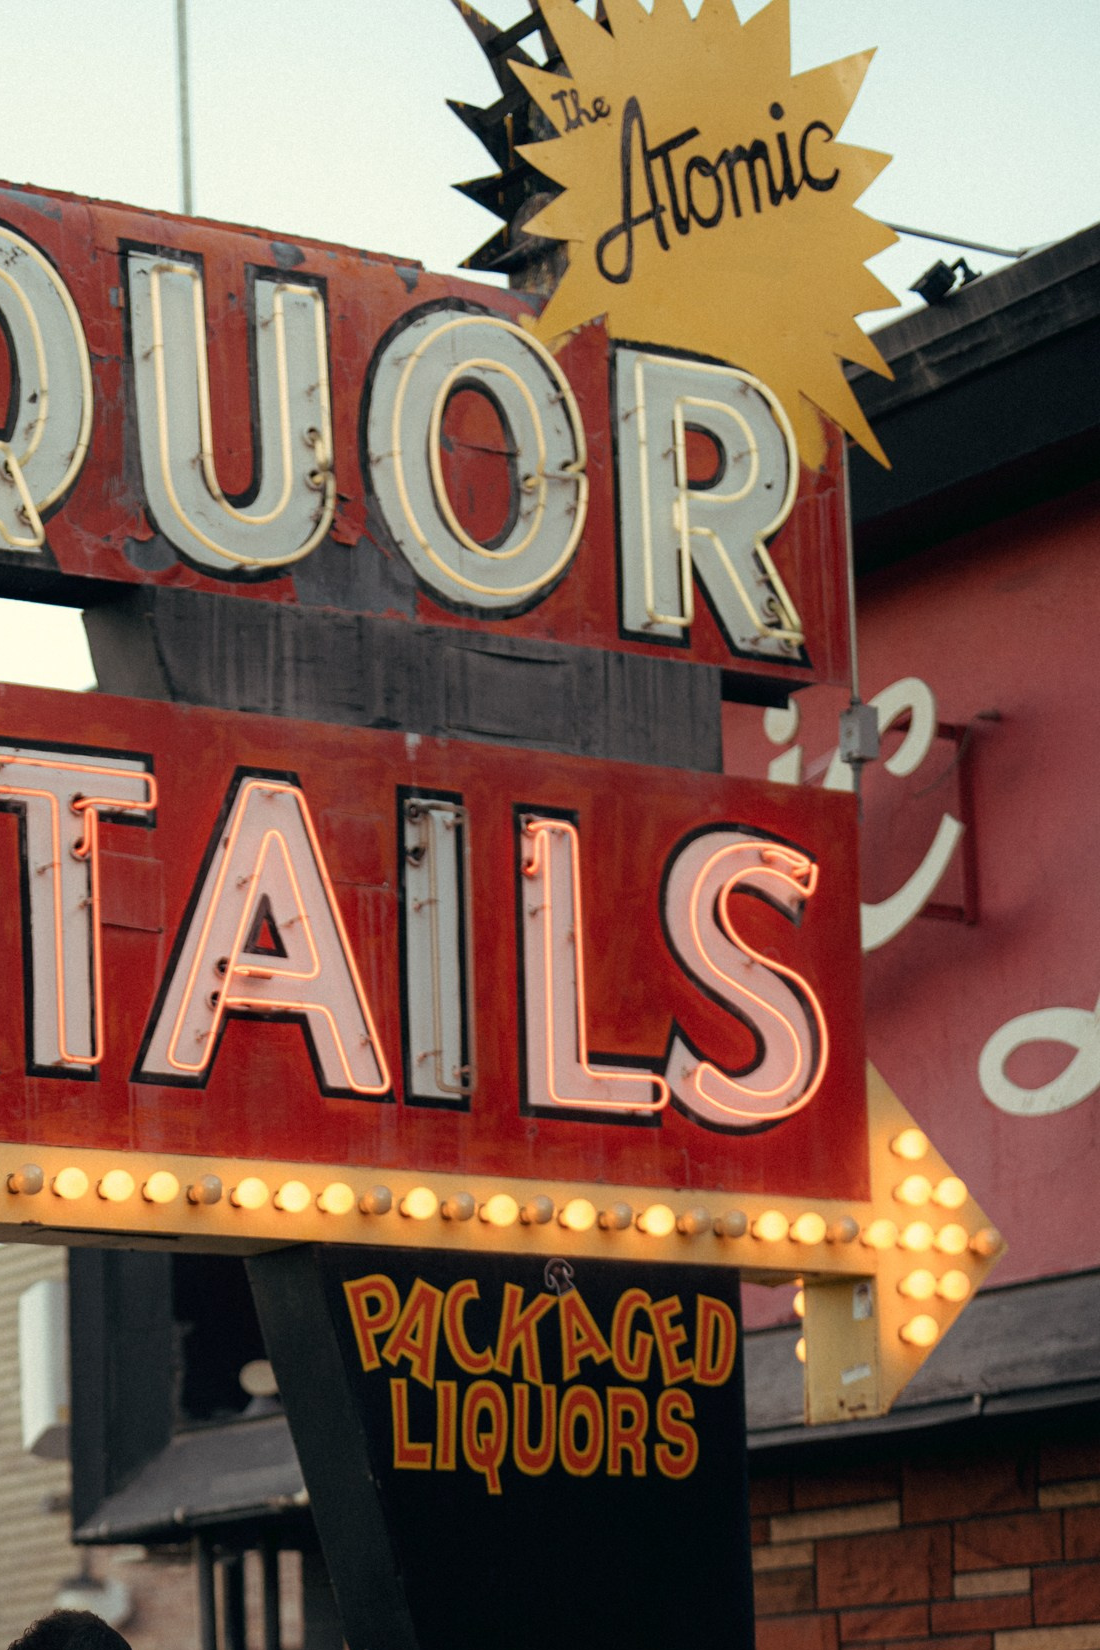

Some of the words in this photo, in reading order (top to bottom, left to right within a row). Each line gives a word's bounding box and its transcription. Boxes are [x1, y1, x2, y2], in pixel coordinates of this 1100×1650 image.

[595, 95, 839, 284] Atomic
[342, 1274, 737, 1389] PACKAGED
[390, 1378, 699, 1495] LIQUORS
